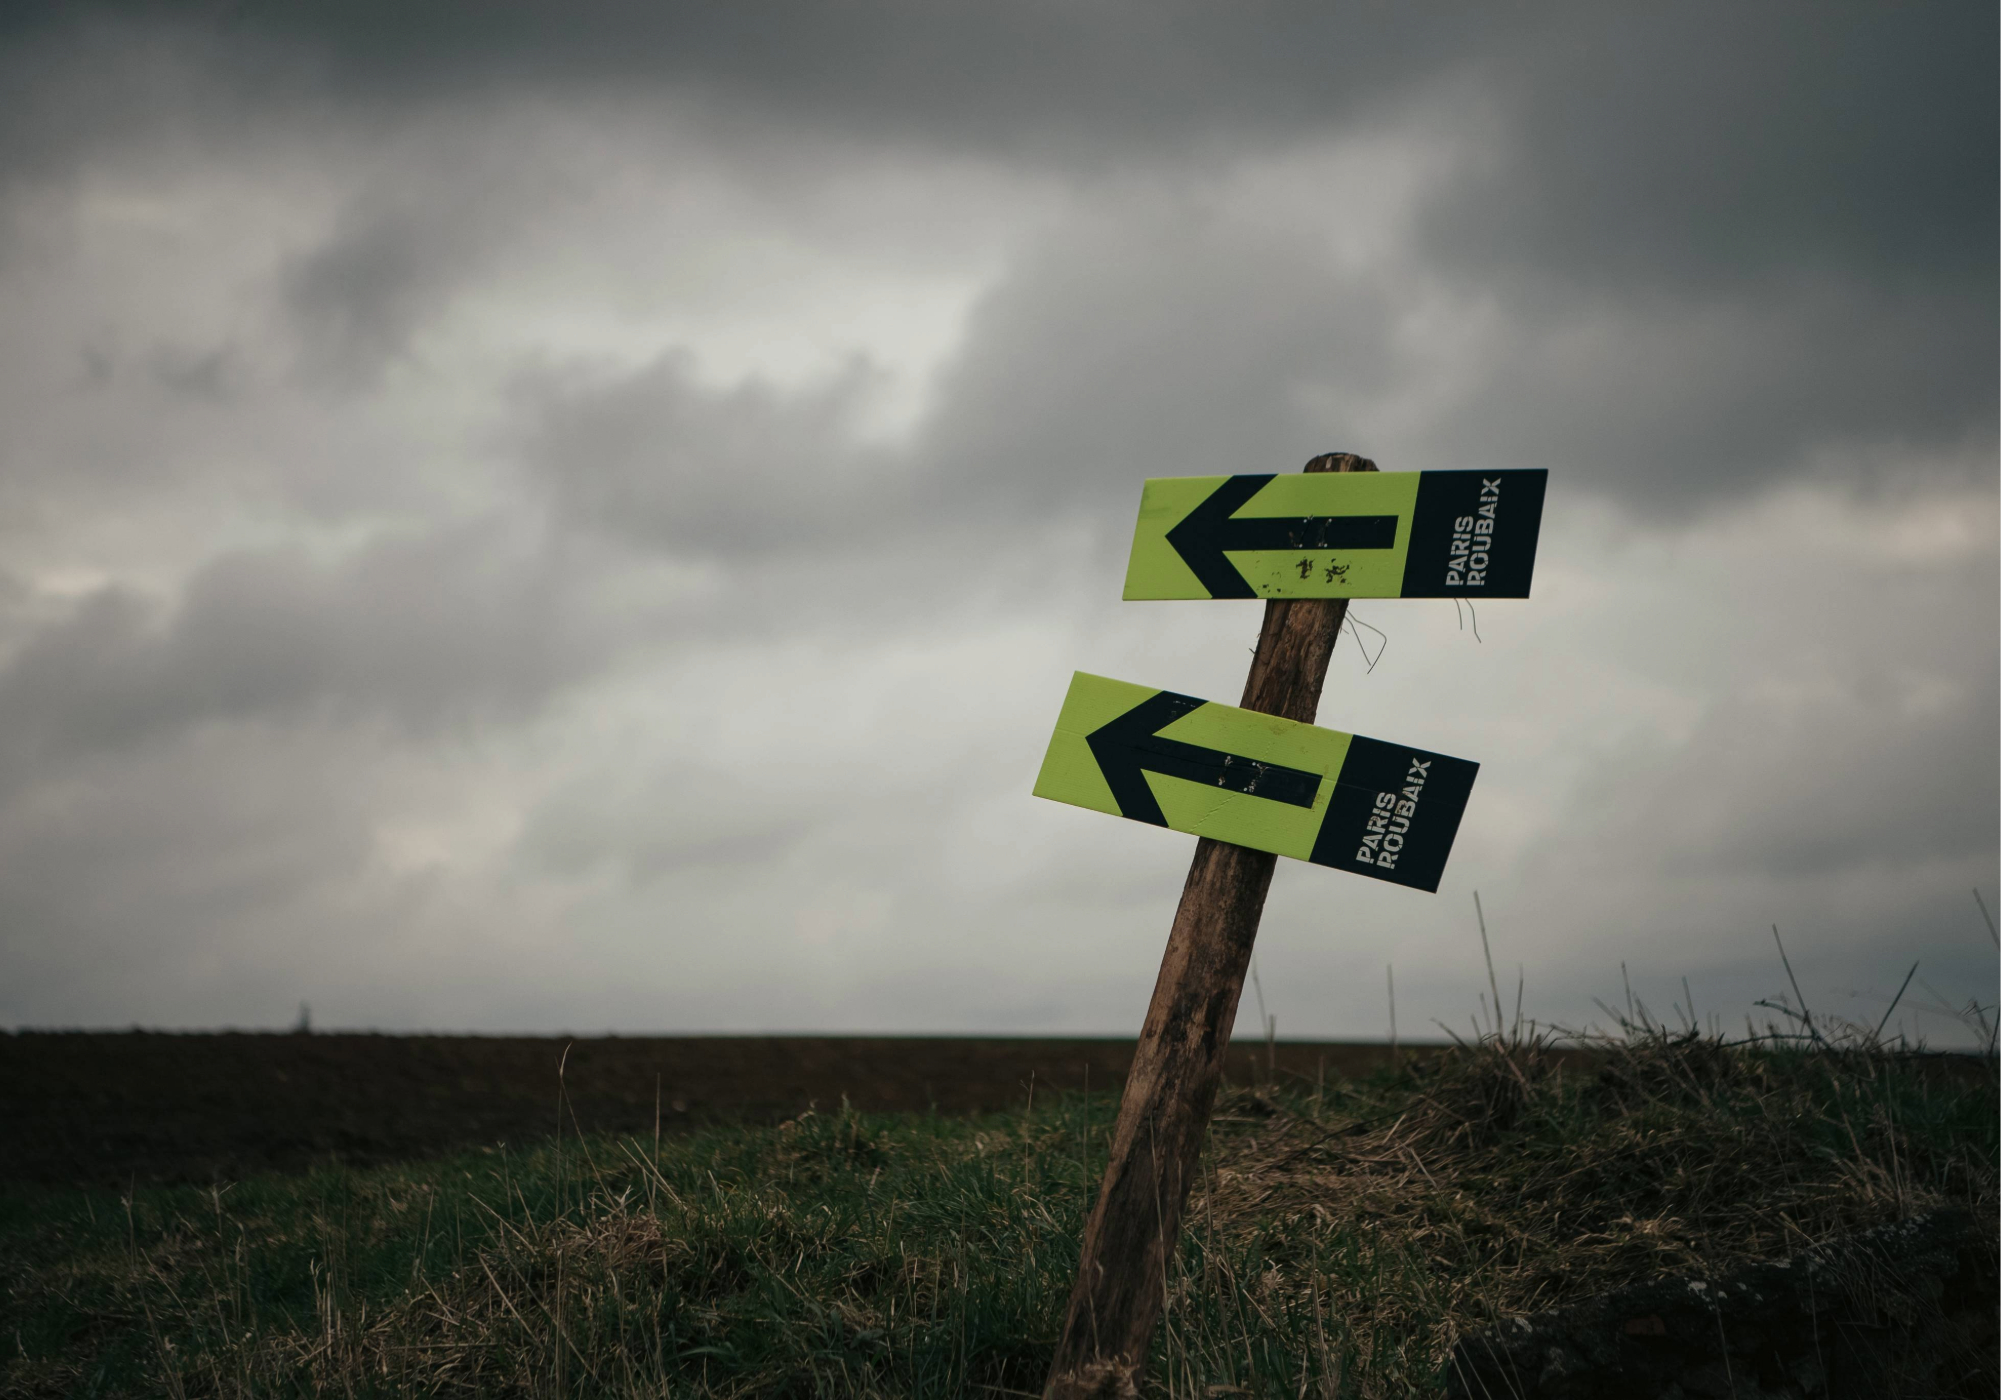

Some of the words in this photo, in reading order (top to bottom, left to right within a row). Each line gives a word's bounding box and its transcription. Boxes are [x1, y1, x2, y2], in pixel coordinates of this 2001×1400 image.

[1445, 516, 1474, 586] PARIS
[1466, 478, 1501, 586] ROUBAIX
[1355, 792, 1396, 864] PARIS
[1377, 757, 1431, 870] ROUBAIX
